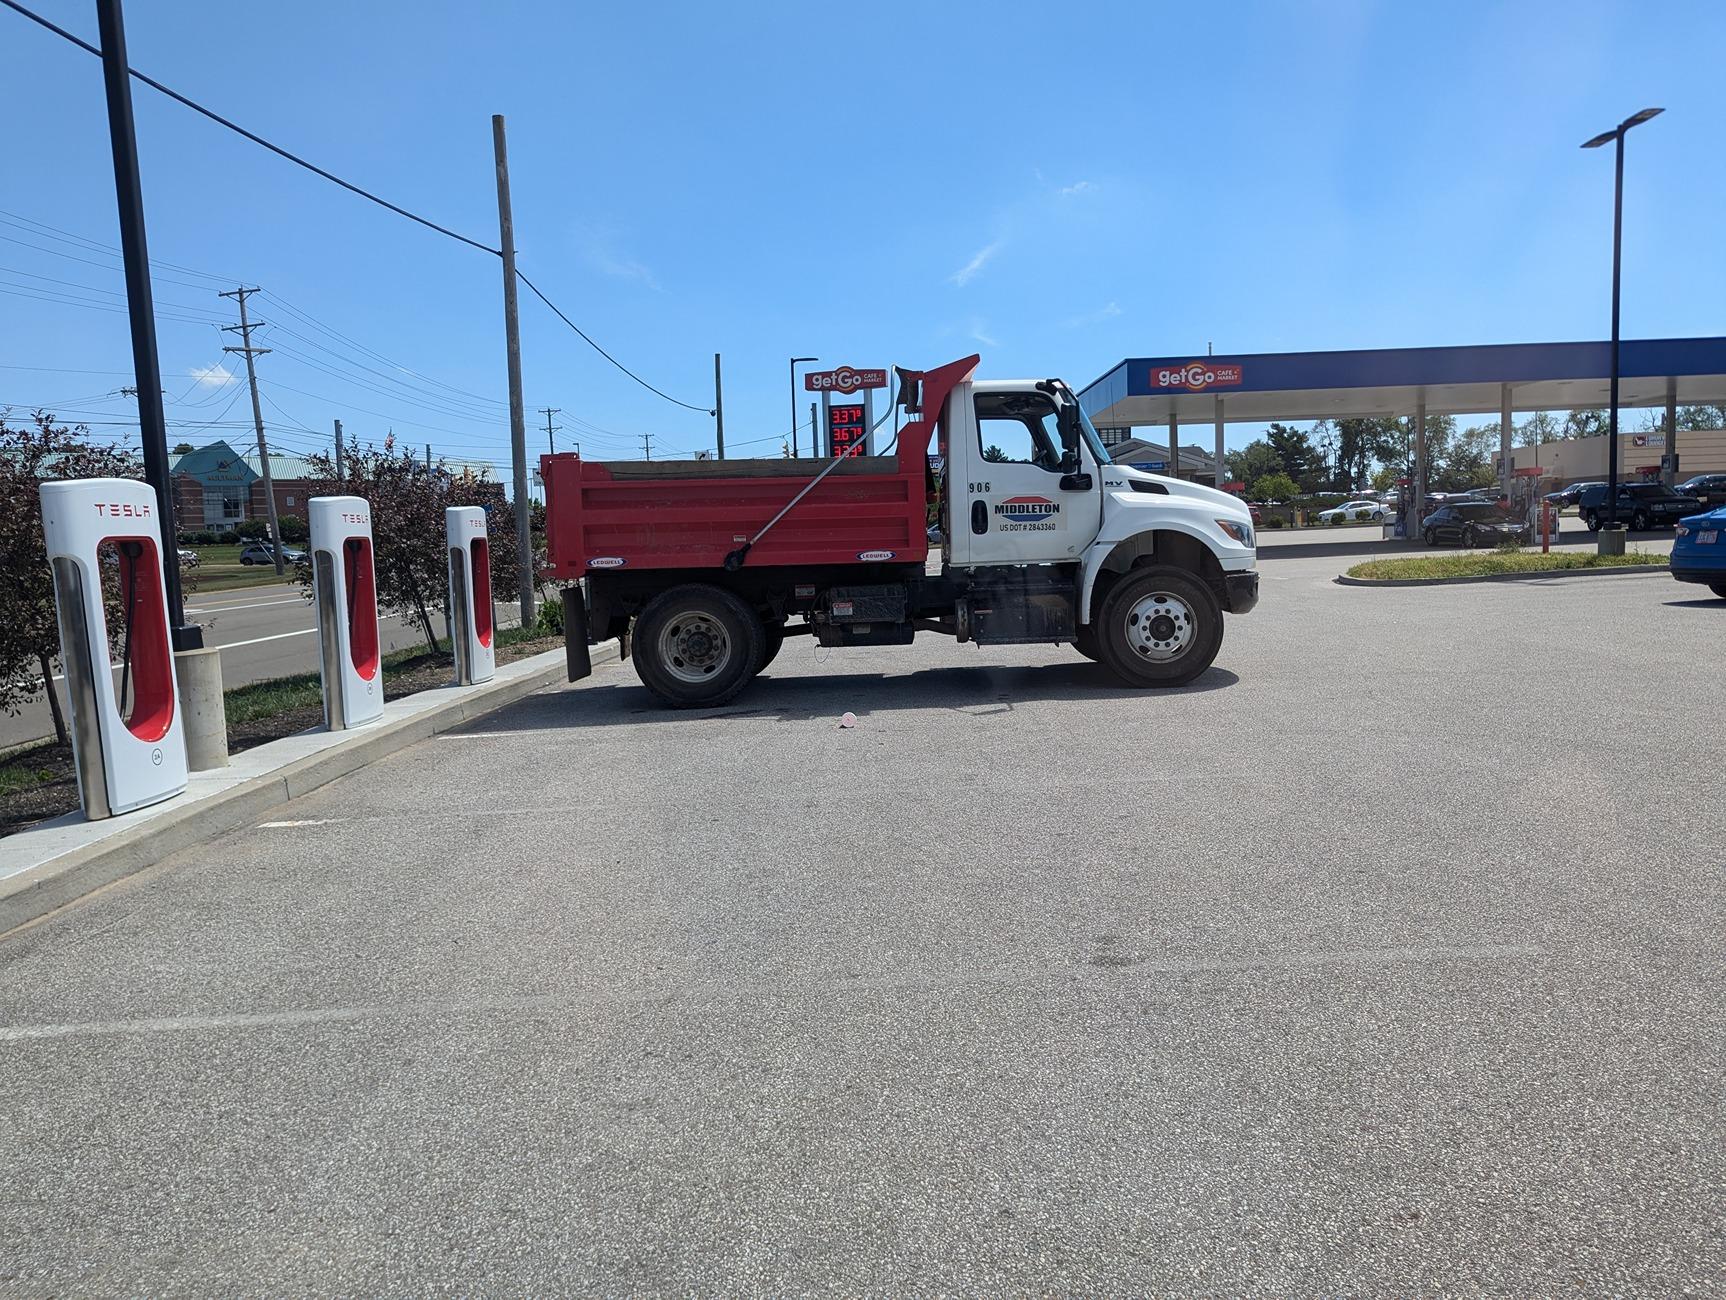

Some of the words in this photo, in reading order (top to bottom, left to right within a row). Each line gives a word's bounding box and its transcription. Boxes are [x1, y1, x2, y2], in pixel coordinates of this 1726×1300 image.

[812, 371, 861, 388] getGo
[1159, 368, 1215, 386] getGo
[969, 482, 990, 493] 906
[94, 503, 151, 518] TESLA
[994, 503, 1060, 514] MIDDLETON
[1028, 523, 1056, 531] 2843360
